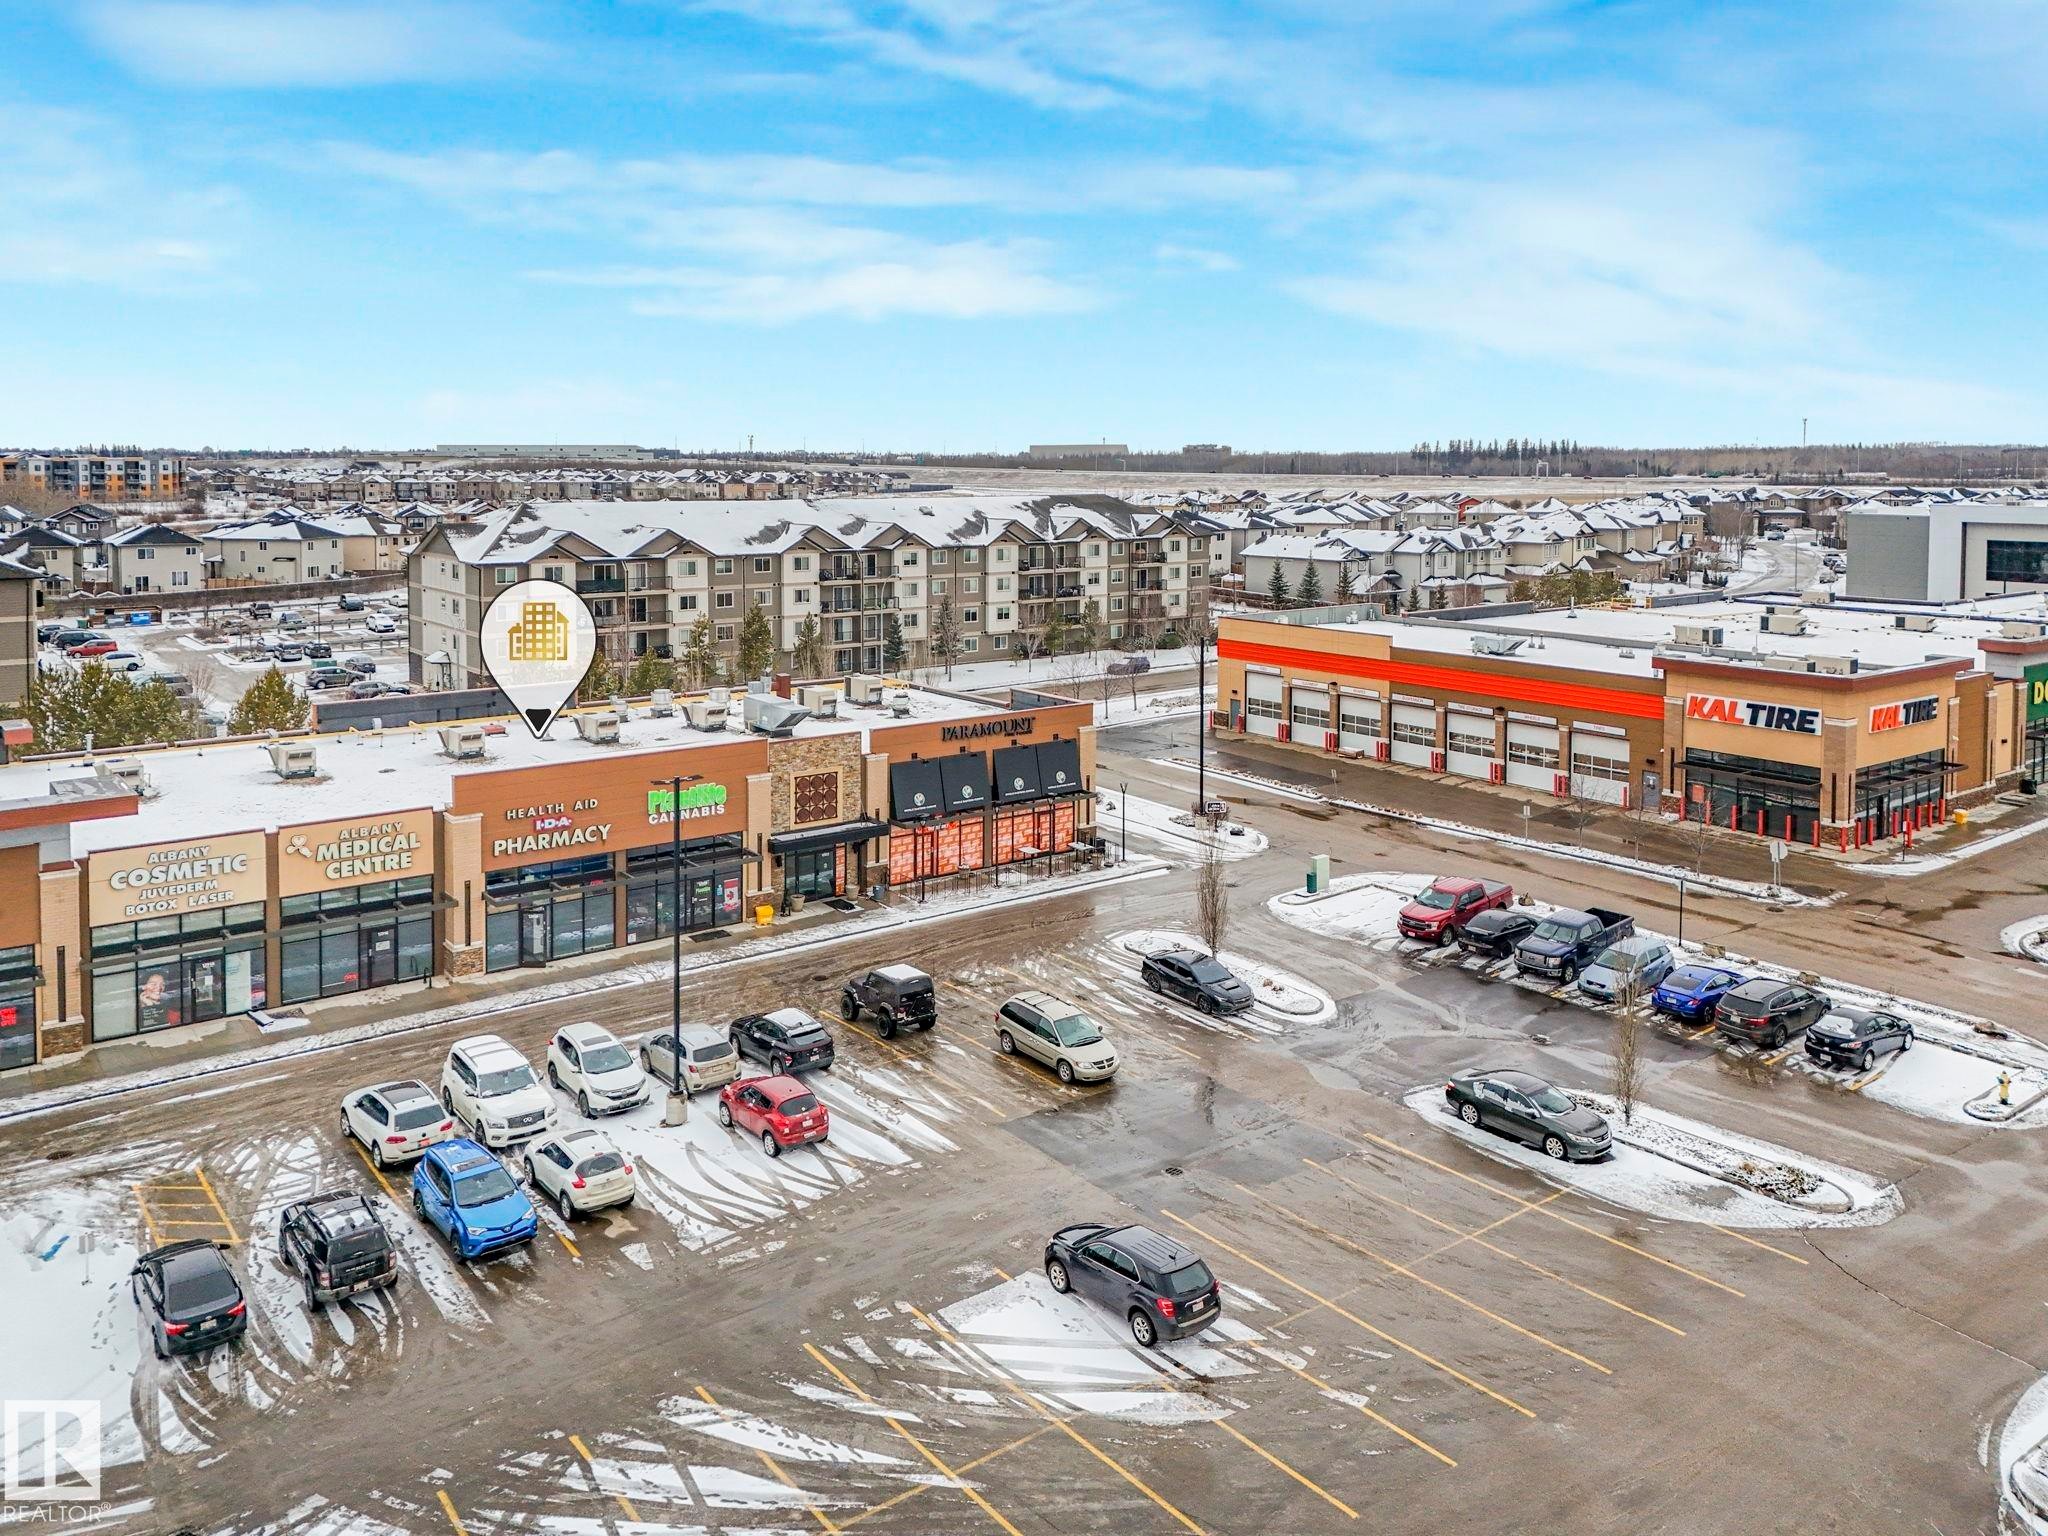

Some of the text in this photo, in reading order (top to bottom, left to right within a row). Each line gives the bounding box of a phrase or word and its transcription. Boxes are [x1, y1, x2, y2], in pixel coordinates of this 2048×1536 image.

[1687, 695, 1820, 734] KAL TIRE
[1871, 697, 1939, 732] KAL TIRE
[942, 717, 1032, 741] PARAMOUNT
[506, 799, 598, 820] HEALTH AID
[339, 821, 403, 840] ALBANY
[493, 824, 611, 857] PHARMACY
[148, 845, 211, 864] ALBANY
[316, 832, 421, 862] MEDICAL
[110, 854, 247, 890] COSMETIC
[326, 852, 412, 880] CENTRE
[139, 879, 218, 900] JUVEDERM
[125, 891, 234, 916] BOTOX LASER
